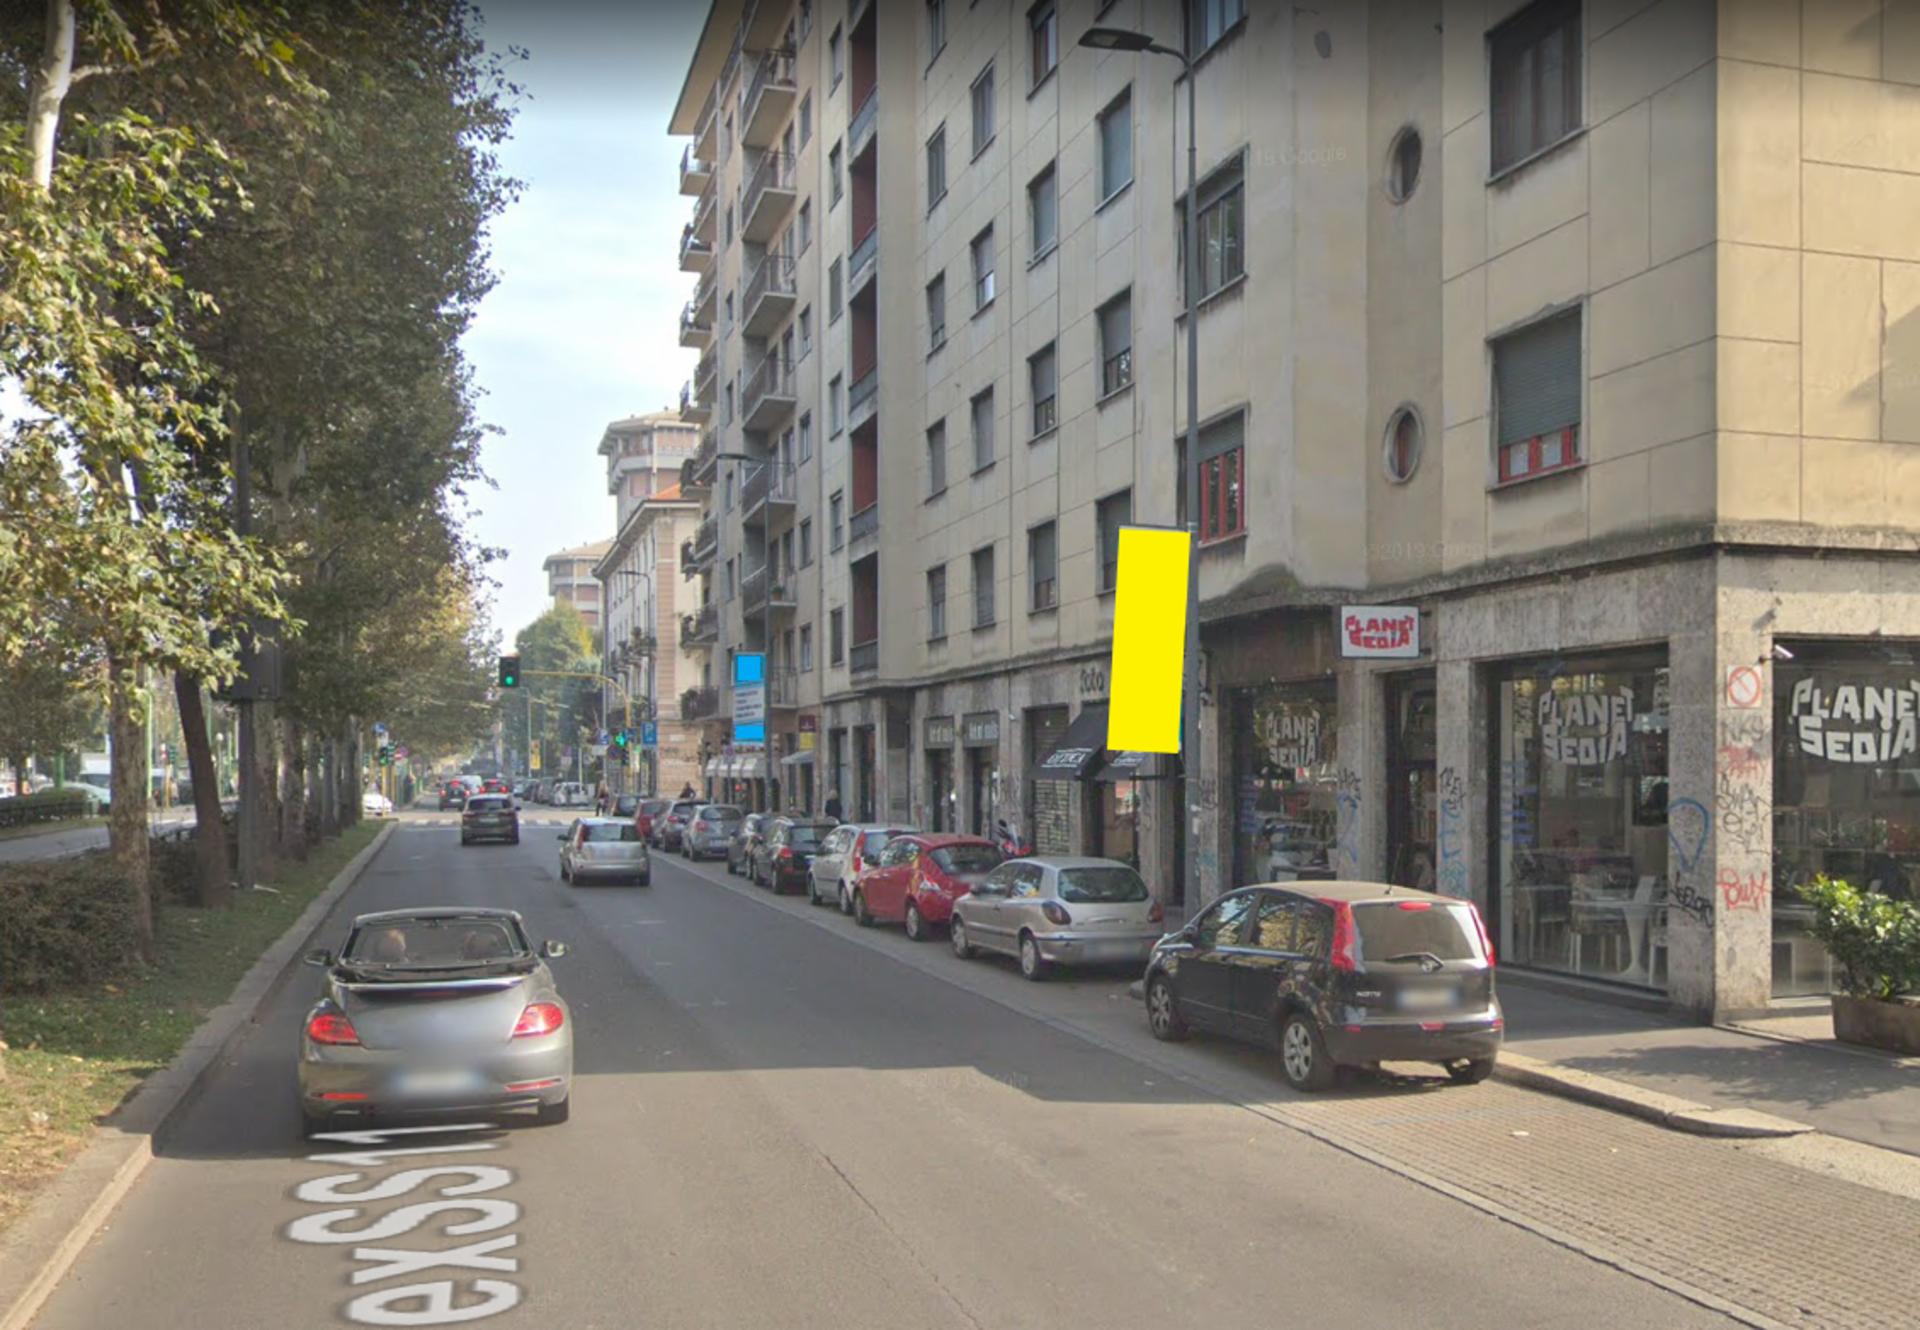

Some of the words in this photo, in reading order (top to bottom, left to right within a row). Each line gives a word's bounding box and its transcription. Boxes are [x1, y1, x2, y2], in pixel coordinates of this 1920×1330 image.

[1345, 614, 1414, 632] PLANET
[1538, 685, 1634, 726] PLANET
[1265, 710, 1320, 740] PLANET
